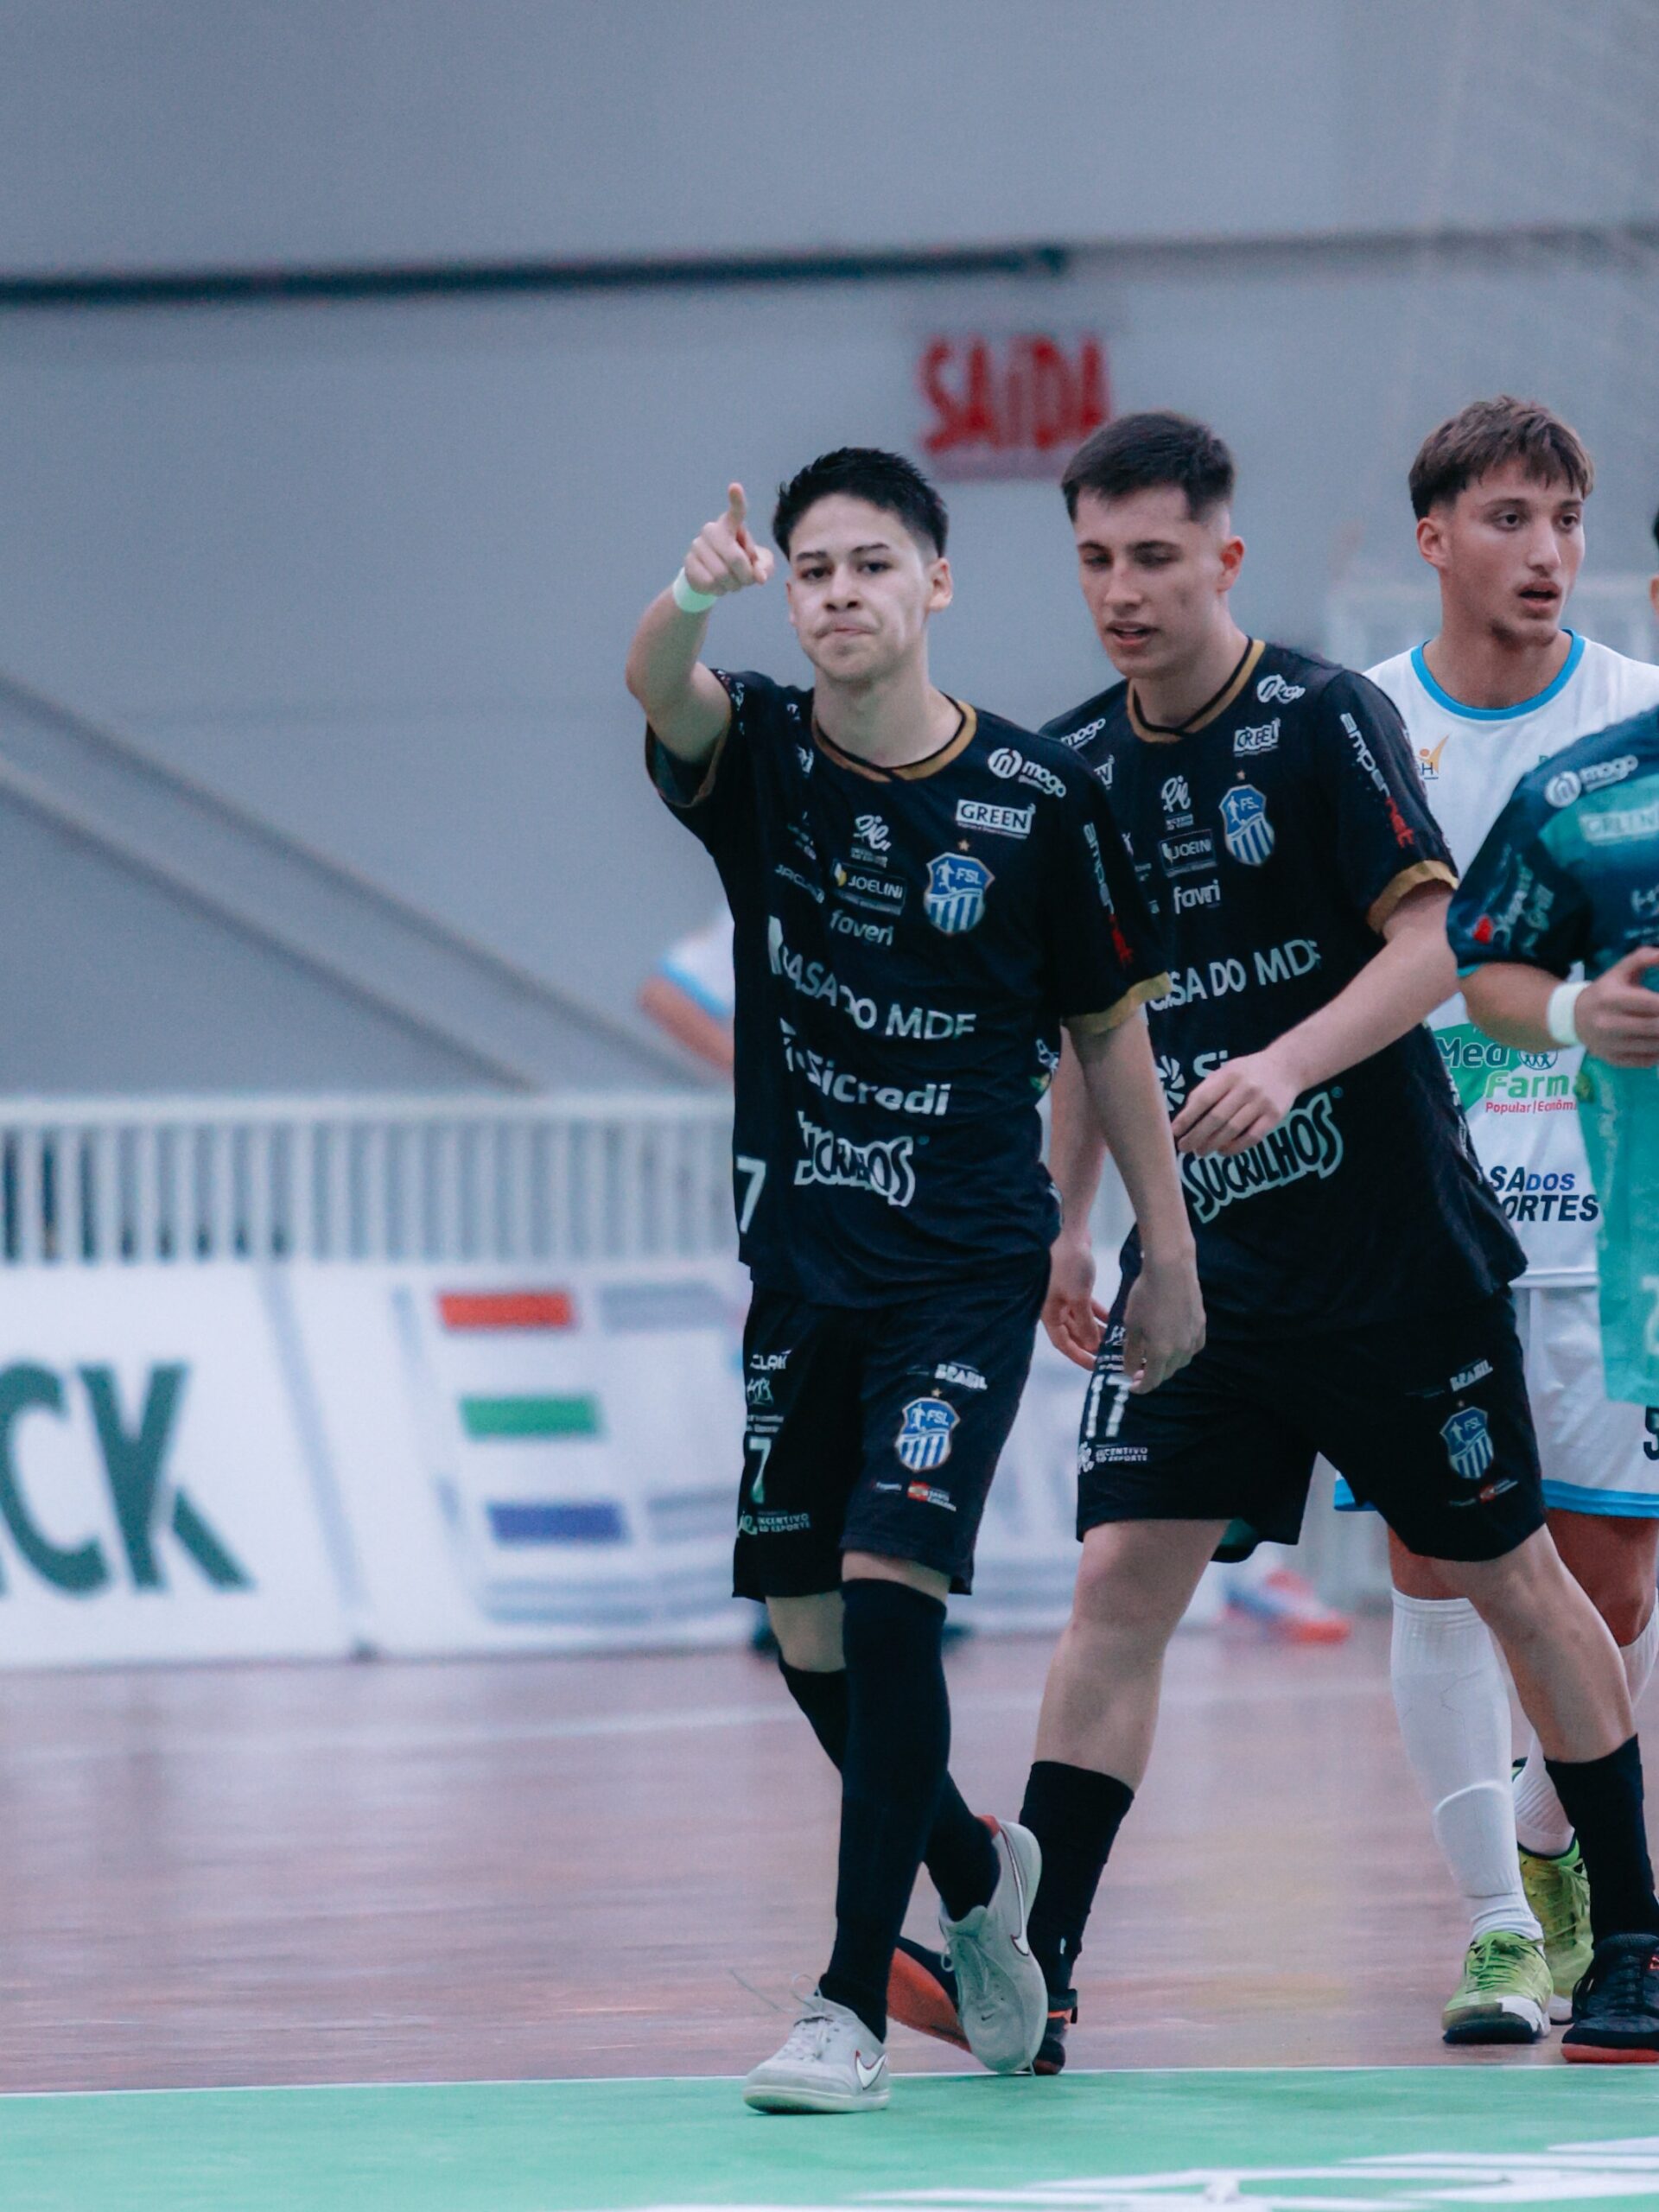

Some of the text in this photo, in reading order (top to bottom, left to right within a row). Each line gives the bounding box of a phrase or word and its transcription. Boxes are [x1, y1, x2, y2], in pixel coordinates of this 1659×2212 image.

[1022, 760, 1066, 798] mogo
[961, 804, 1028, 830] GREEN
[955, 868, 982, 886] FSL
[830, 909, 894, 946] faveri
[1210, 957, 1247, 997] DO
[885, 1003, 976, 1039] MDF
[1485, 1102, 1532, 1115] Popular
[1177, 1091, 1344, 1224] SUCRILHOS
[736, 1154, 766, 1234] 7
[926, 1408, 950, 1426] FSL
[1085, 1372, 1133, 1439] 17
[0, 1360, 252, 1600] CK
[749, 1436, 772, 1503] 7
